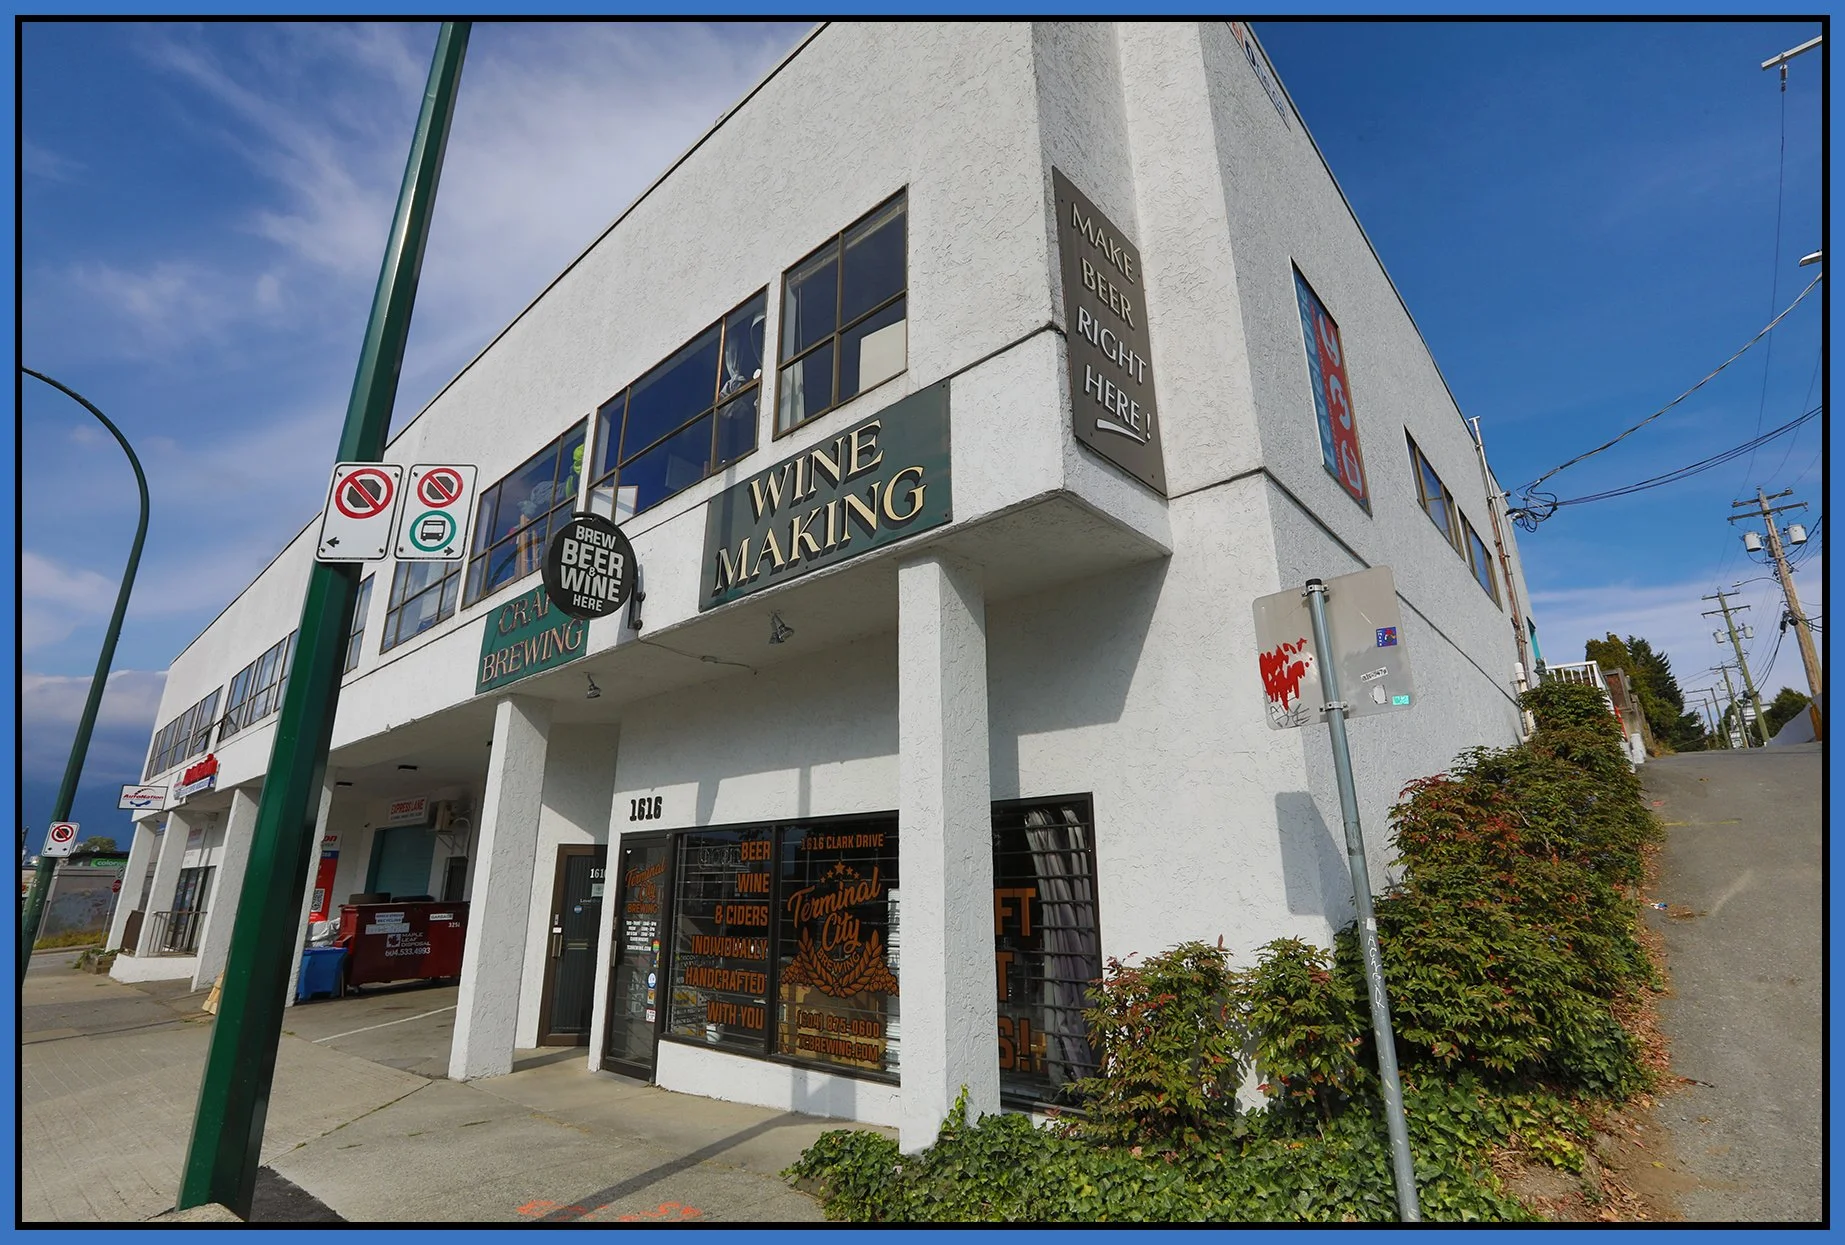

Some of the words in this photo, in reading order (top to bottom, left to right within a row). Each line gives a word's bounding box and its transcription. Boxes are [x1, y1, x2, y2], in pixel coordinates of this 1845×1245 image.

[1072, 202, 1135, 284] MAKE
[1081, 256, 1135, 330] BEER
[1077, 306, 1147, 384] RIGHT
[749, 419, 884, 520] WINE
[575, 525, 616, 550] BREW
[713, 466, 927, 593] MAKING
[561, 538, 624, 579] BEER
[588, 566, 596, 577] &
[560, 565, 621, 603] WINE
[572, 594, 603, 612] HERE
[482, 618, 583, 683] BREWING
[630, 796, 662, 821] 1616
[742, 841, 770, 861] BEER
[801, 837, 824, 850] 1616
[826, 835, 854, 849] CLARK
[856, 834, 884, 848] DRIVE
[590, 867, 606, 879] 161
[625, 856, 666, 889] Terminal
[737, 873, 769, 893] WINE
[627, 903, 658, 914] BREWING
[787, 866, 882, 928] Terminal
[715, 905, 723, 925] &
[726, 906, 768, 926] CIDERS
[821, 912, 862, 953] City
[692, 935, 768, 961] INDIVIDUALLY
[816, 949, 861, 974] BREWING
[684, 966, 765, 995] HANDCRAFTED
[707, 1001, 736, 1024] WITH
[740, 1007, 764, 1029] YOU
[797, 1010, 824, 1032] (604)
[826, 1016, 880, 1038] 875-0600
